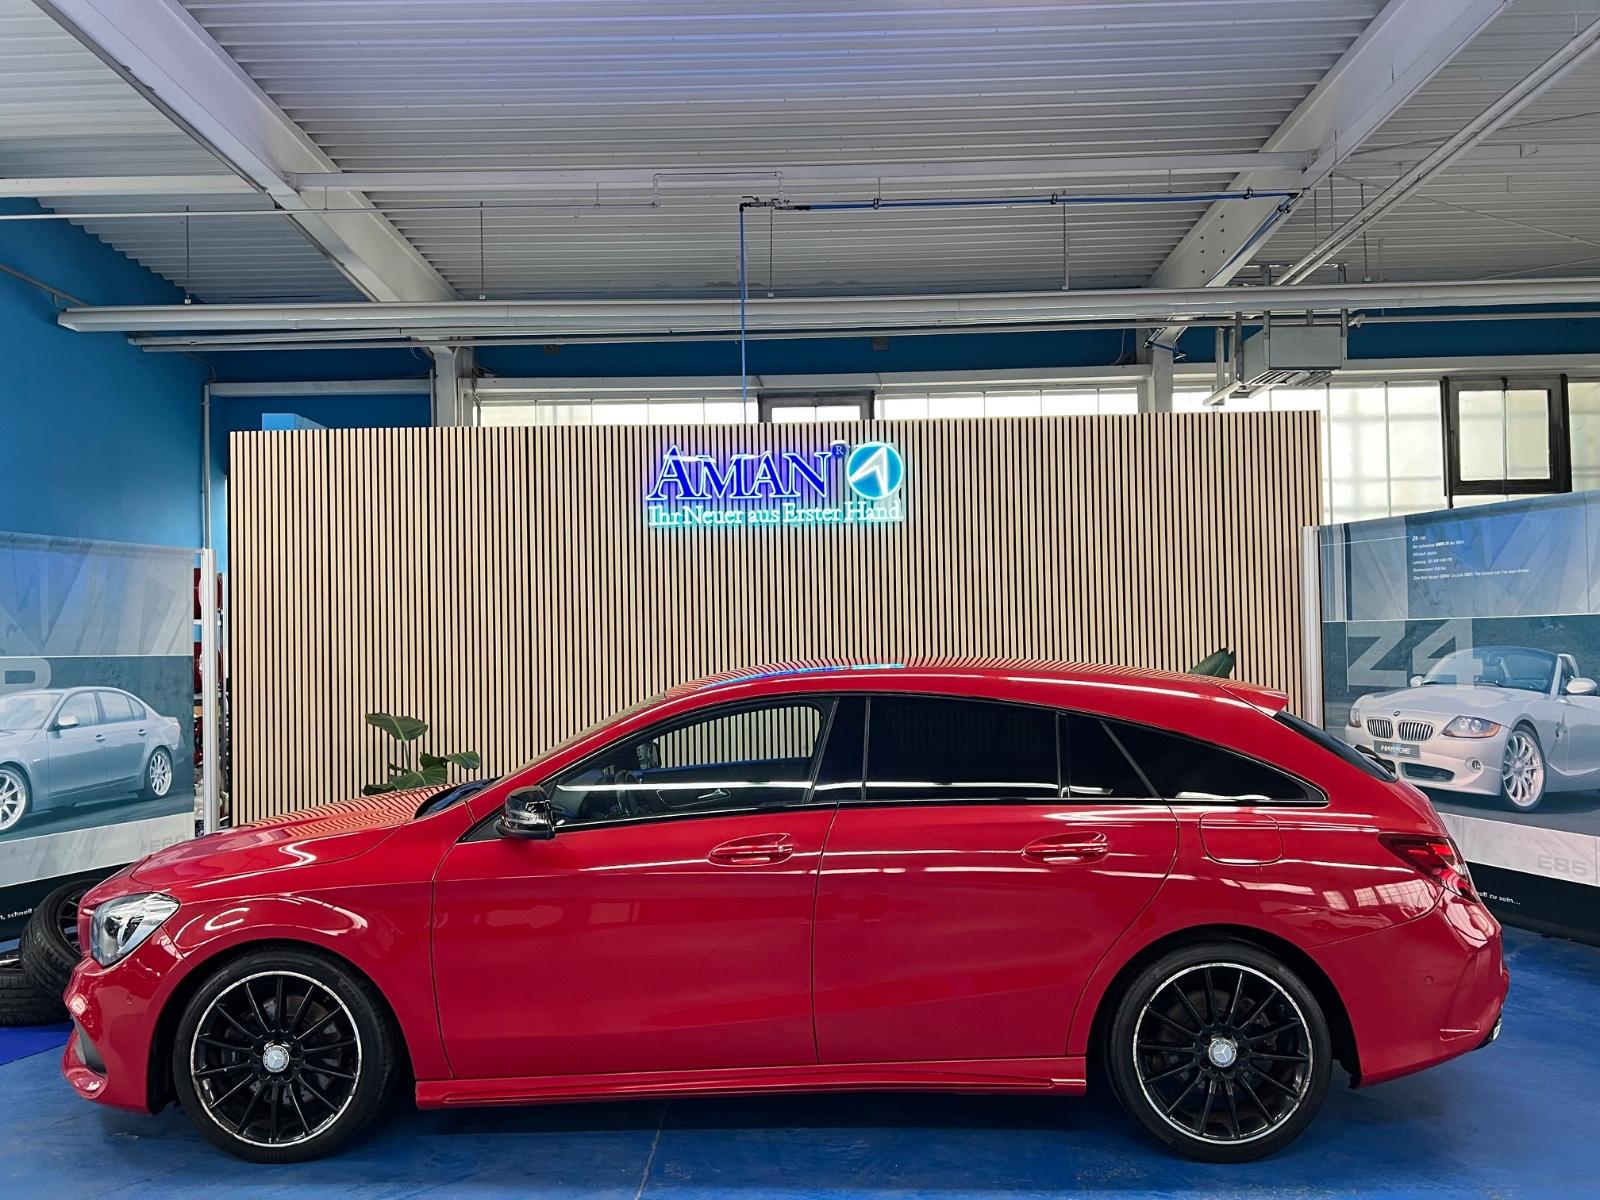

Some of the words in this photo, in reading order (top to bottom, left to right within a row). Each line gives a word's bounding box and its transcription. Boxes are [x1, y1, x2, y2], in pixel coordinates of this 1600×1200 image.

[646, 445, 831, 500] AMAN
[648, 504, 681, 526] Ihr
[683, 505, 744, 525] Neuer
[748, 509, 780, 523] aus
[783, 502, 842, 523] Erster
[1348, 619, 1483, 688] Z4
[1537, 854, 1588, 877] E85
